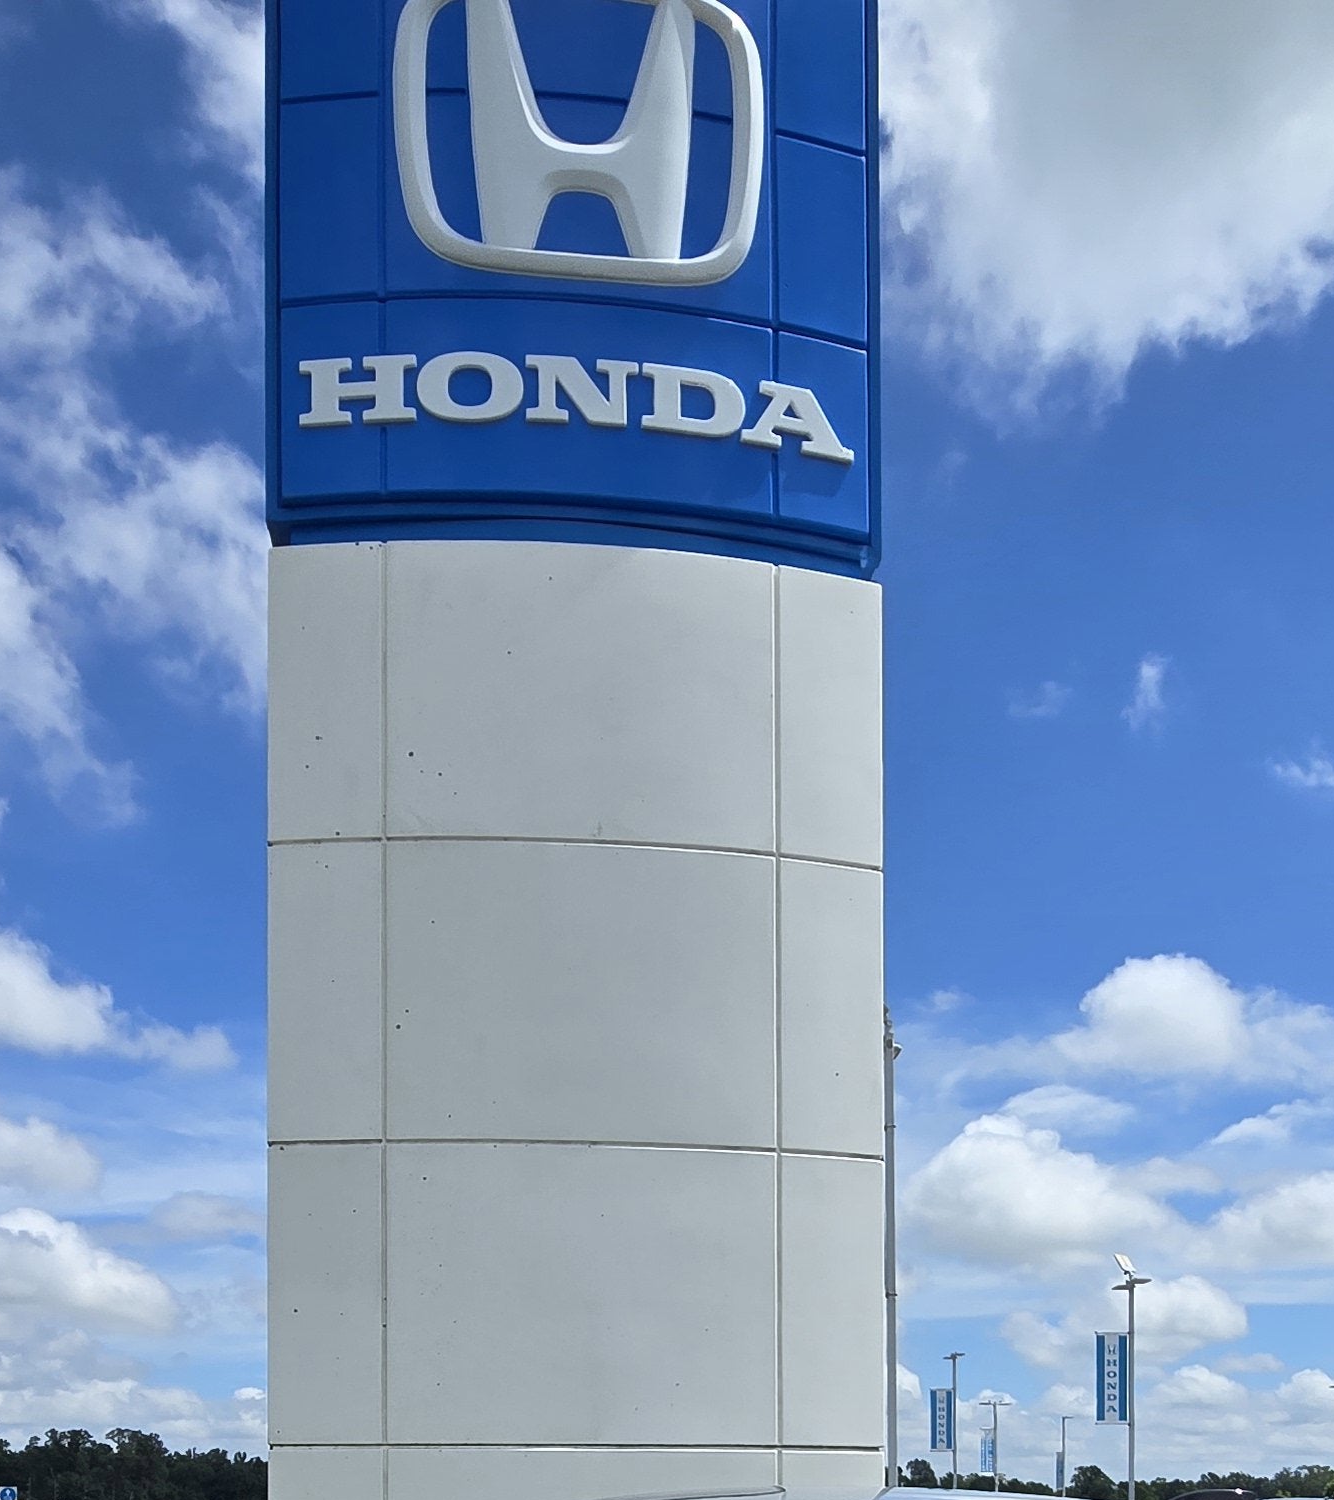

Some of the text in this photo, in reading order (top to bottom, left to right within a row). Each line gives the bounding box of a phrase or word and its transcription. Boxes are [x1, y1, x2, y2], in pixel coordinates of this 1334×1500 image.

[299, 351, 855, 464] HONDA
[1106, 1358, 1118, 1413] HONDA
[937, 1406, 946, 1444] HONDA
